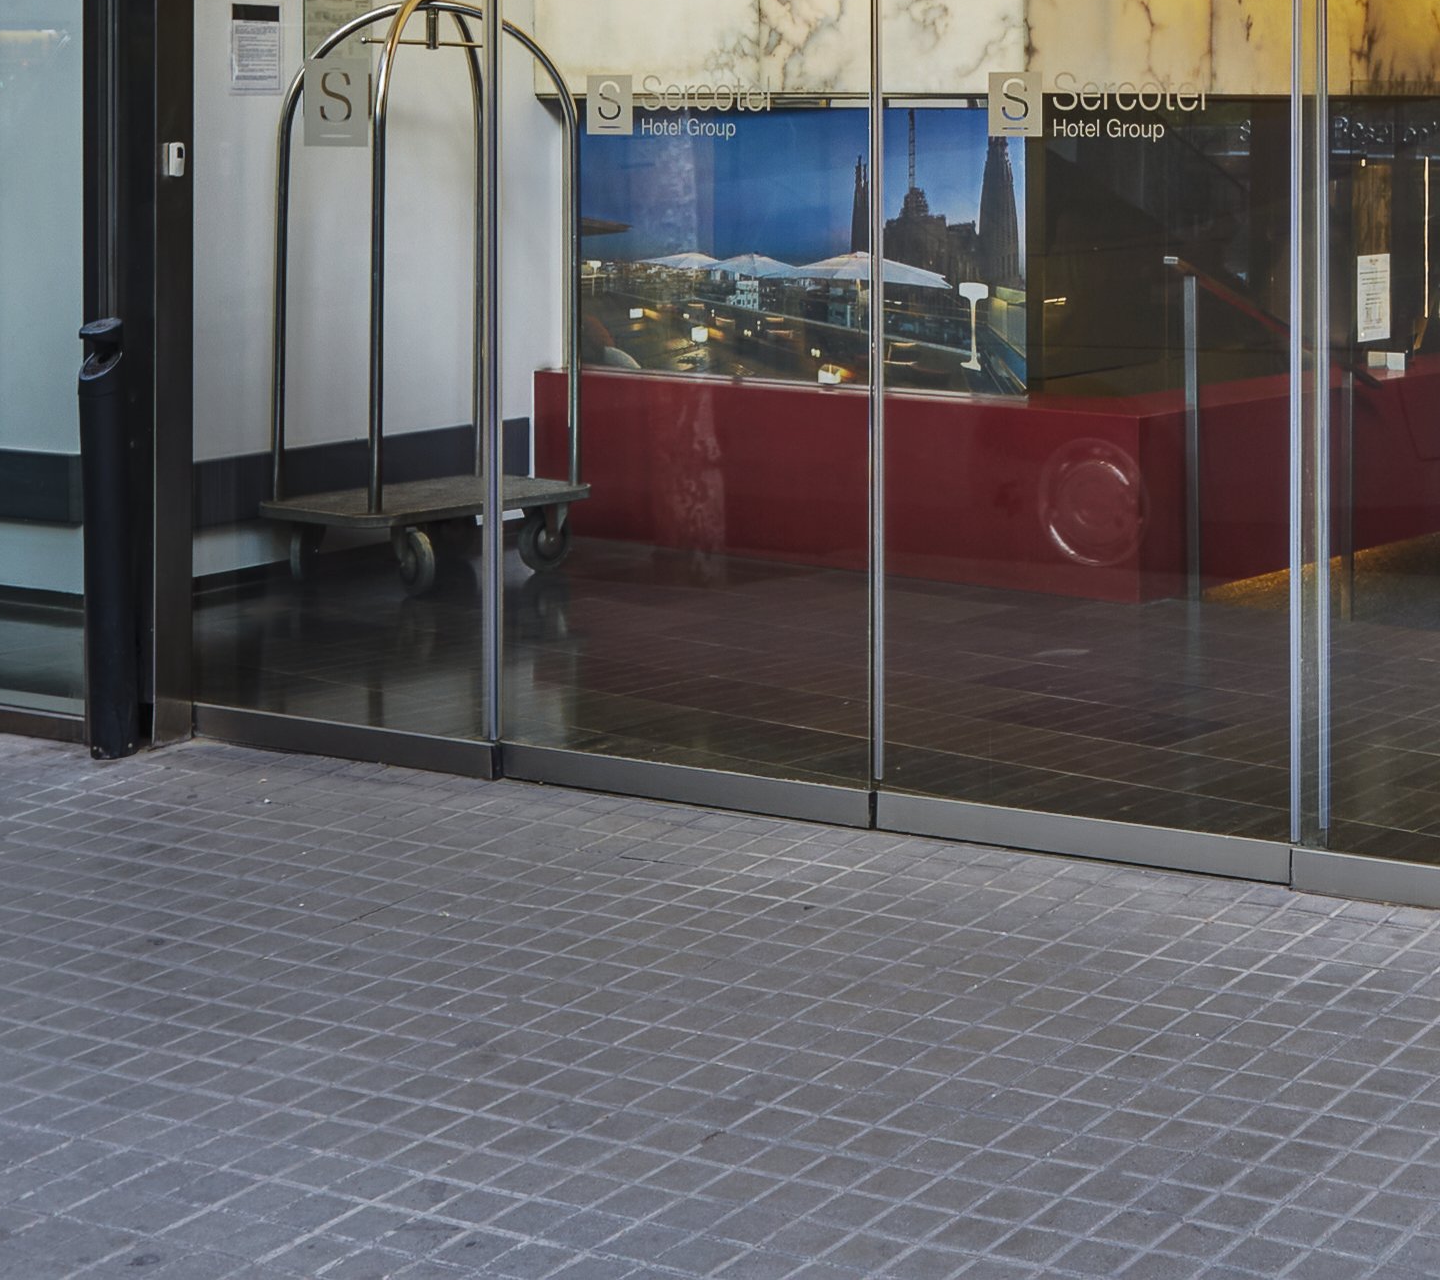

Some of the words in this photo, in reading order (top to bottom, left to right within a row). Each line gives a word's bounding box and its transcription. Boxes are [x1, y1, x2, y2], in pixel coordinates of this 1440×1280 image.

[320, 68, 353, 124] S
[598, 80, 622, 121] S
[641, 75, 771, 112] Sercotel
[1002, 77, 1030, 121] S
[1052, 71, 1207, 111] Sercotel
[641, 118, 681, 136] Hotel
[687, 118, 736, 140] Group
[1053, 118, 1100, 138] Hotel
[1107, 118, 1165, 142] Group
